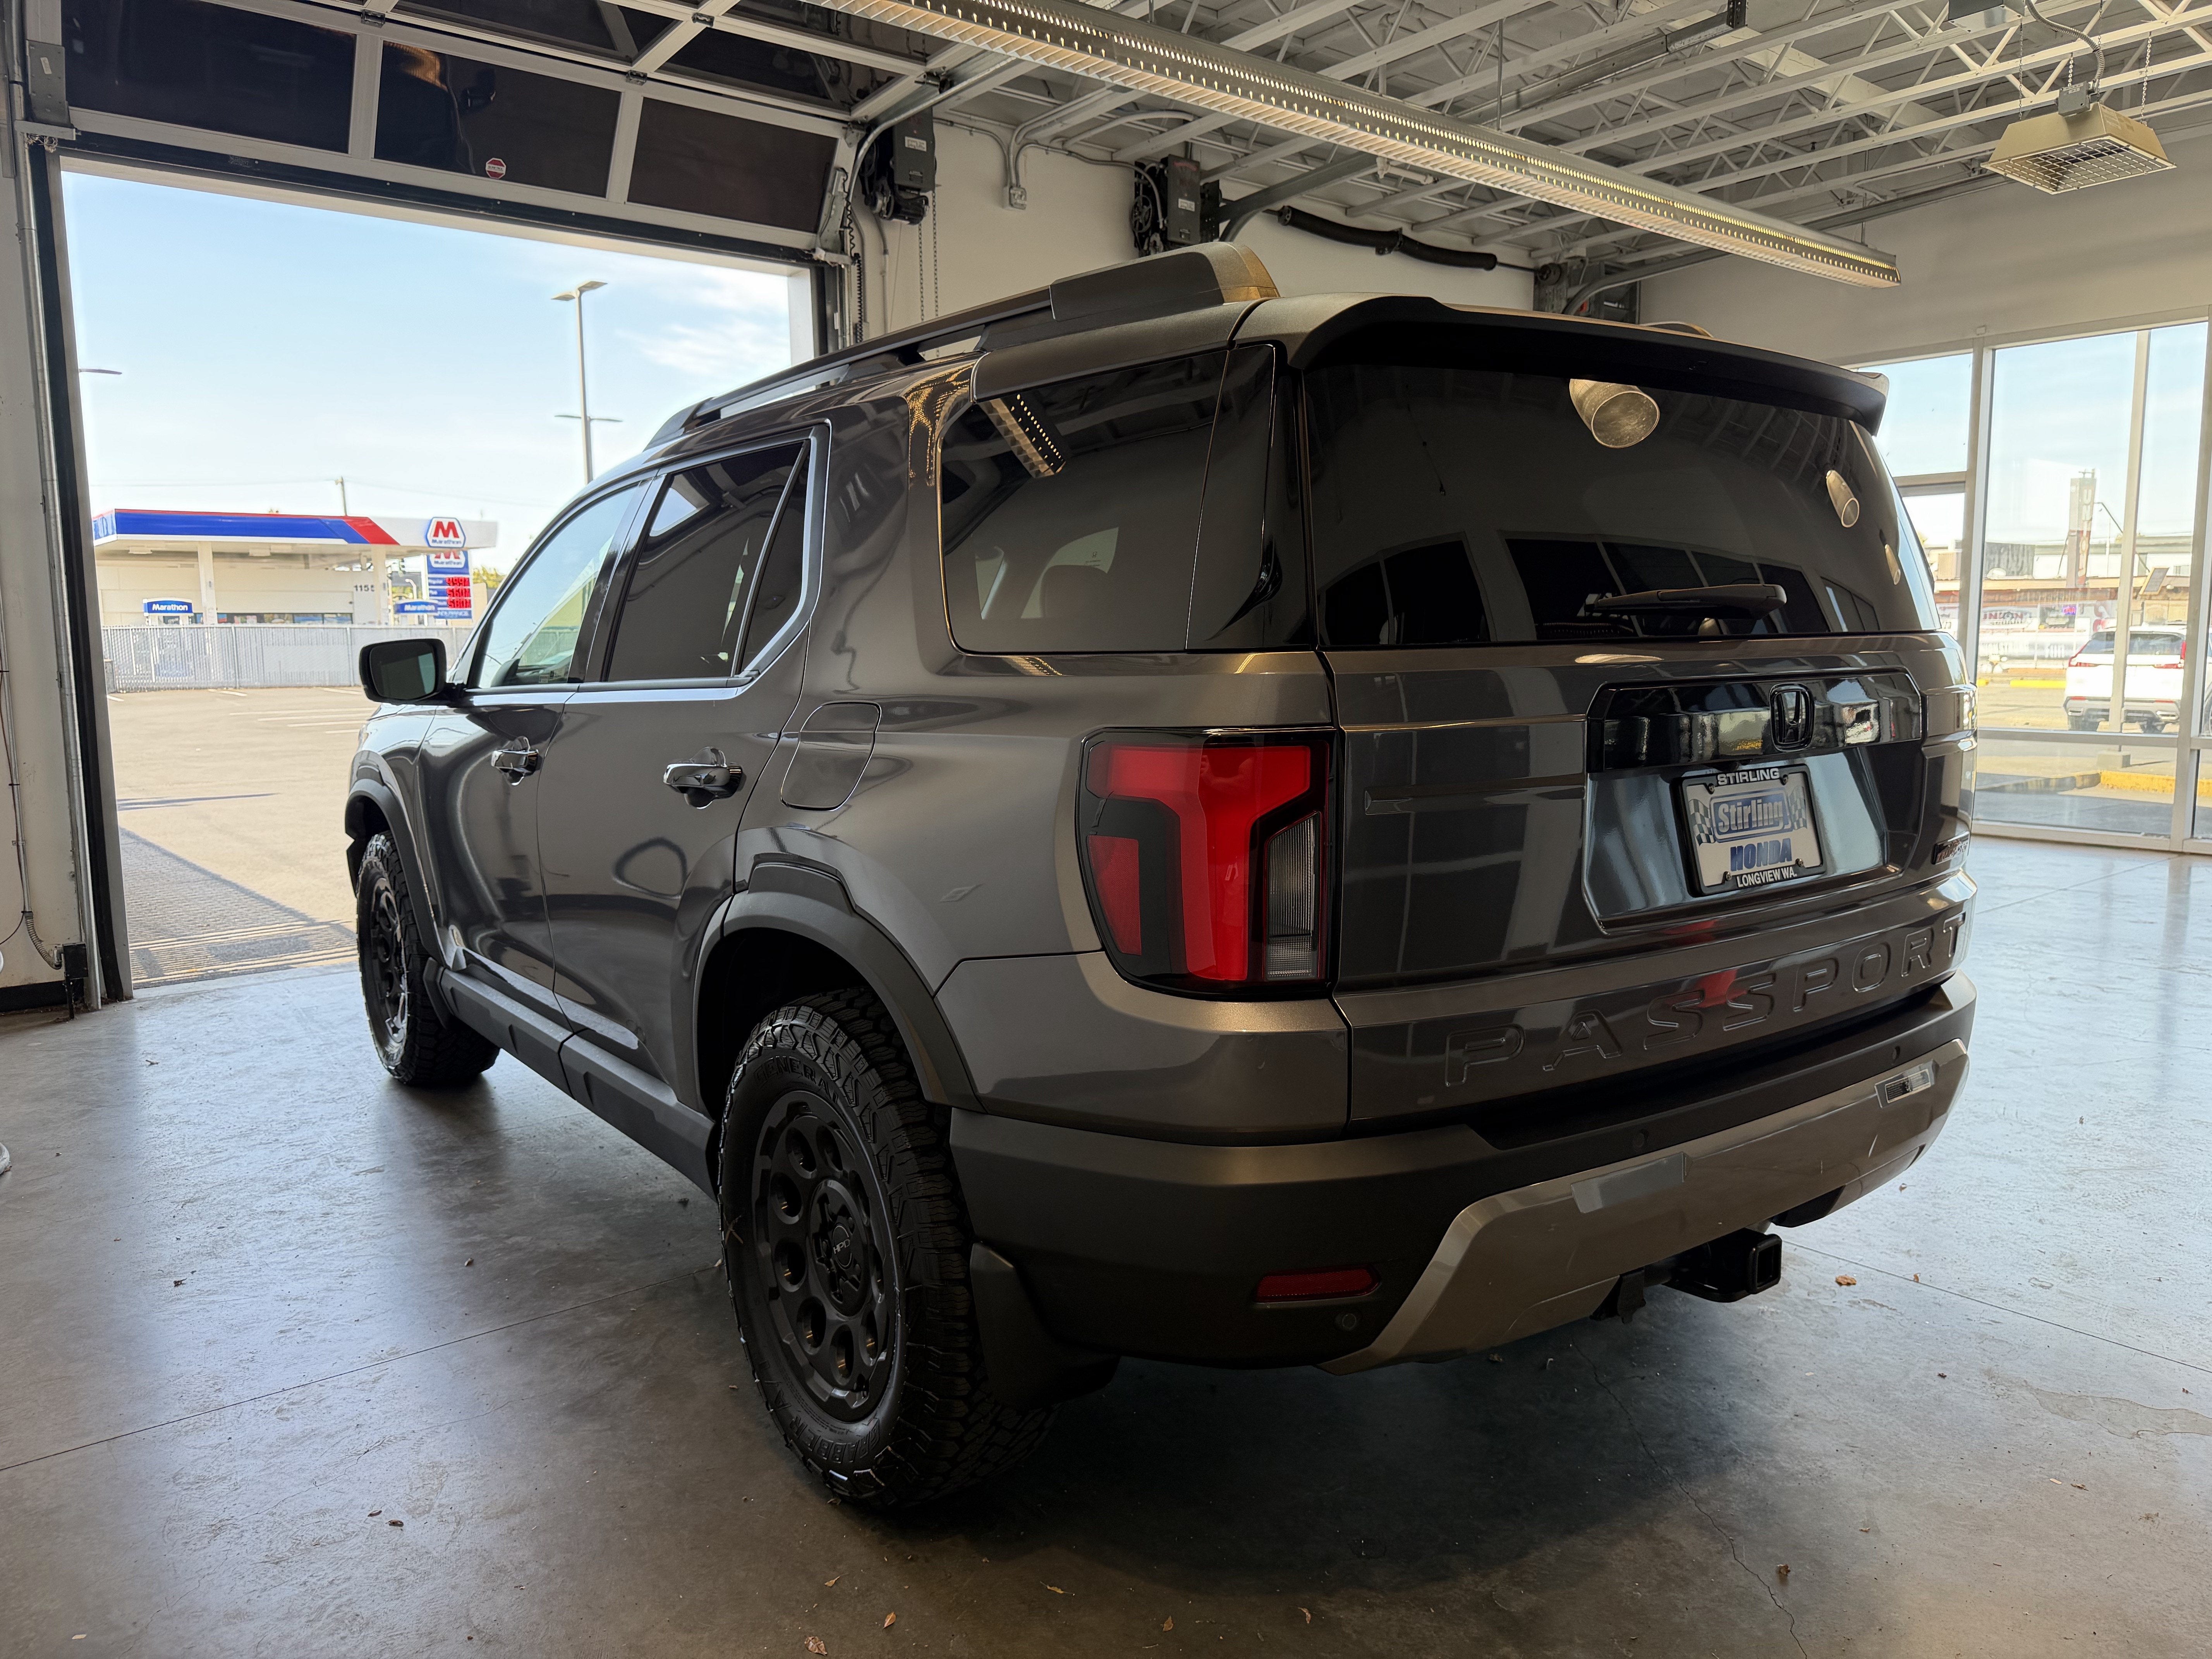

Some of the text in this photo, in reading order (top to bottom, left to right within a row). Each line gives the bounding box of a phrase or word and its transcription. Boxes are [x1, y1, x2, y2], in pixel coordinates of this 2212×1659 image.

[1717, 768, 1780, 785] STIRLING
[1718, 799, 1784, 833] Stirling
[1730, 838, 1793, 871] HONDA
[1736, 866, 1797, 888] LONGVIEW WA.
[1445, 910, 1967, 1087] PASSPORT
[833, 1238, 851, 1254] HPD
